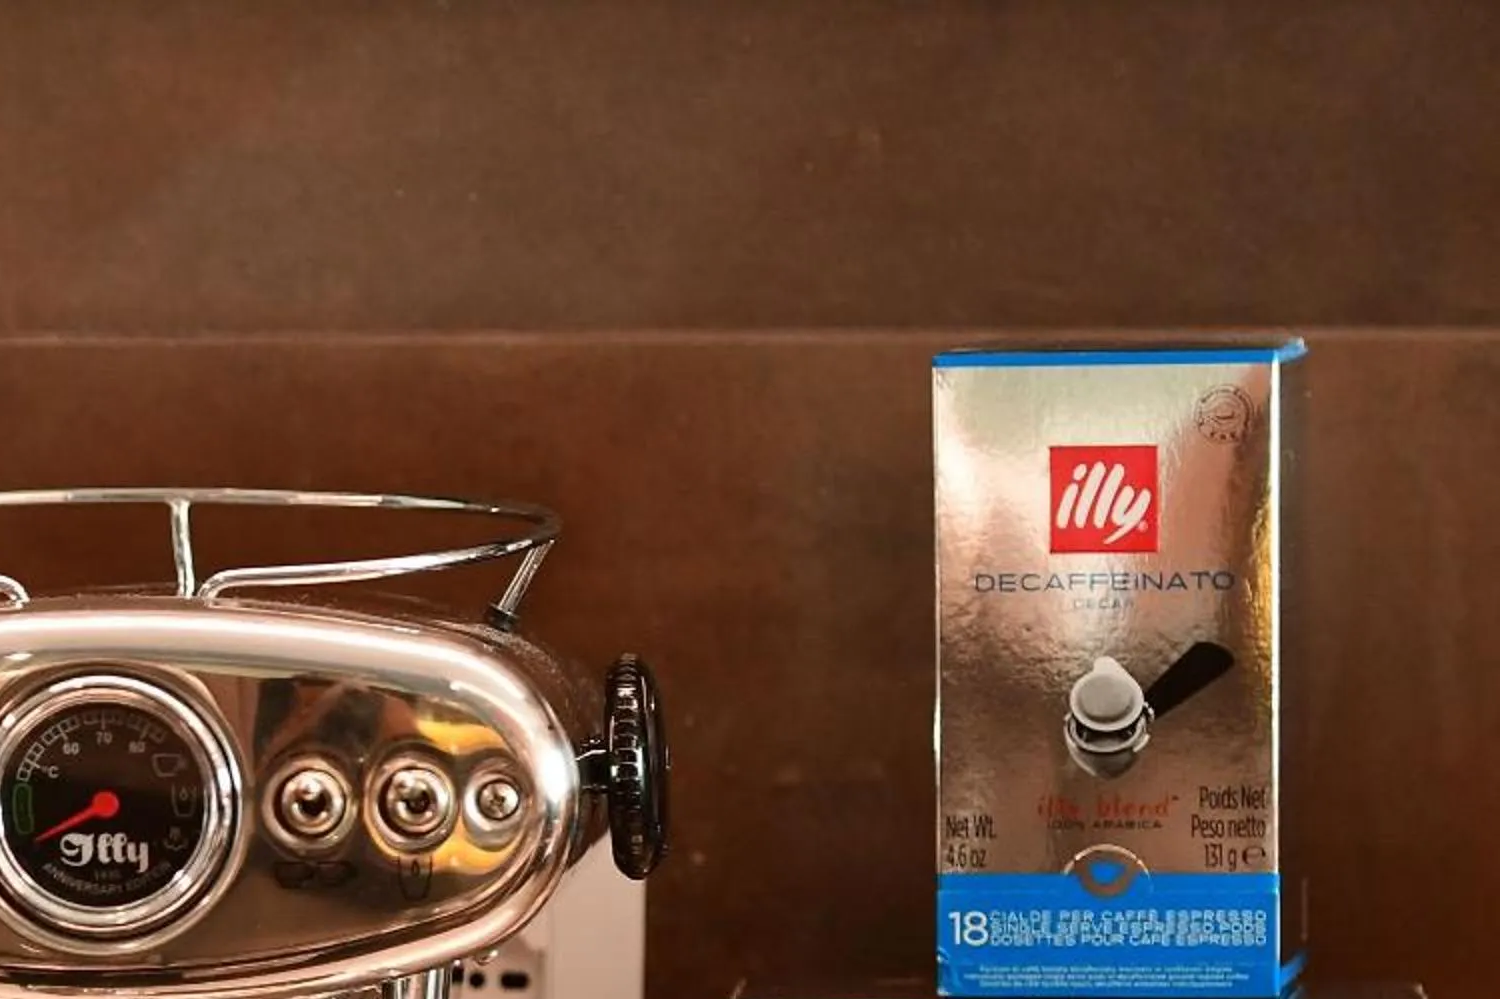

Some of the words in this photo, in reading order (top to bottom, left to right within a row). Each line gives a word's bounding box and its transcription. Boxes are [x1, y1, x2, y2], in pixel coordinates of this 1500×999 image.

[1056, 461, 1152, 545] illy
[975, 570, 1234, 594] DECAFFEINATO
[63, 742, 80, 755] 60
[96, 731, 113, 745] 70
[1199, 785, 1238, 809] Poids
[1241, 784, 1266, 809] Net
[946, 815, 969, 839] Net
[1190, 814, 1224, 838] Peso
[1228, 815, 1267, 838] netto
[1204, 843, 1224, 868] 131
[948, 910, 989, 946] 18
